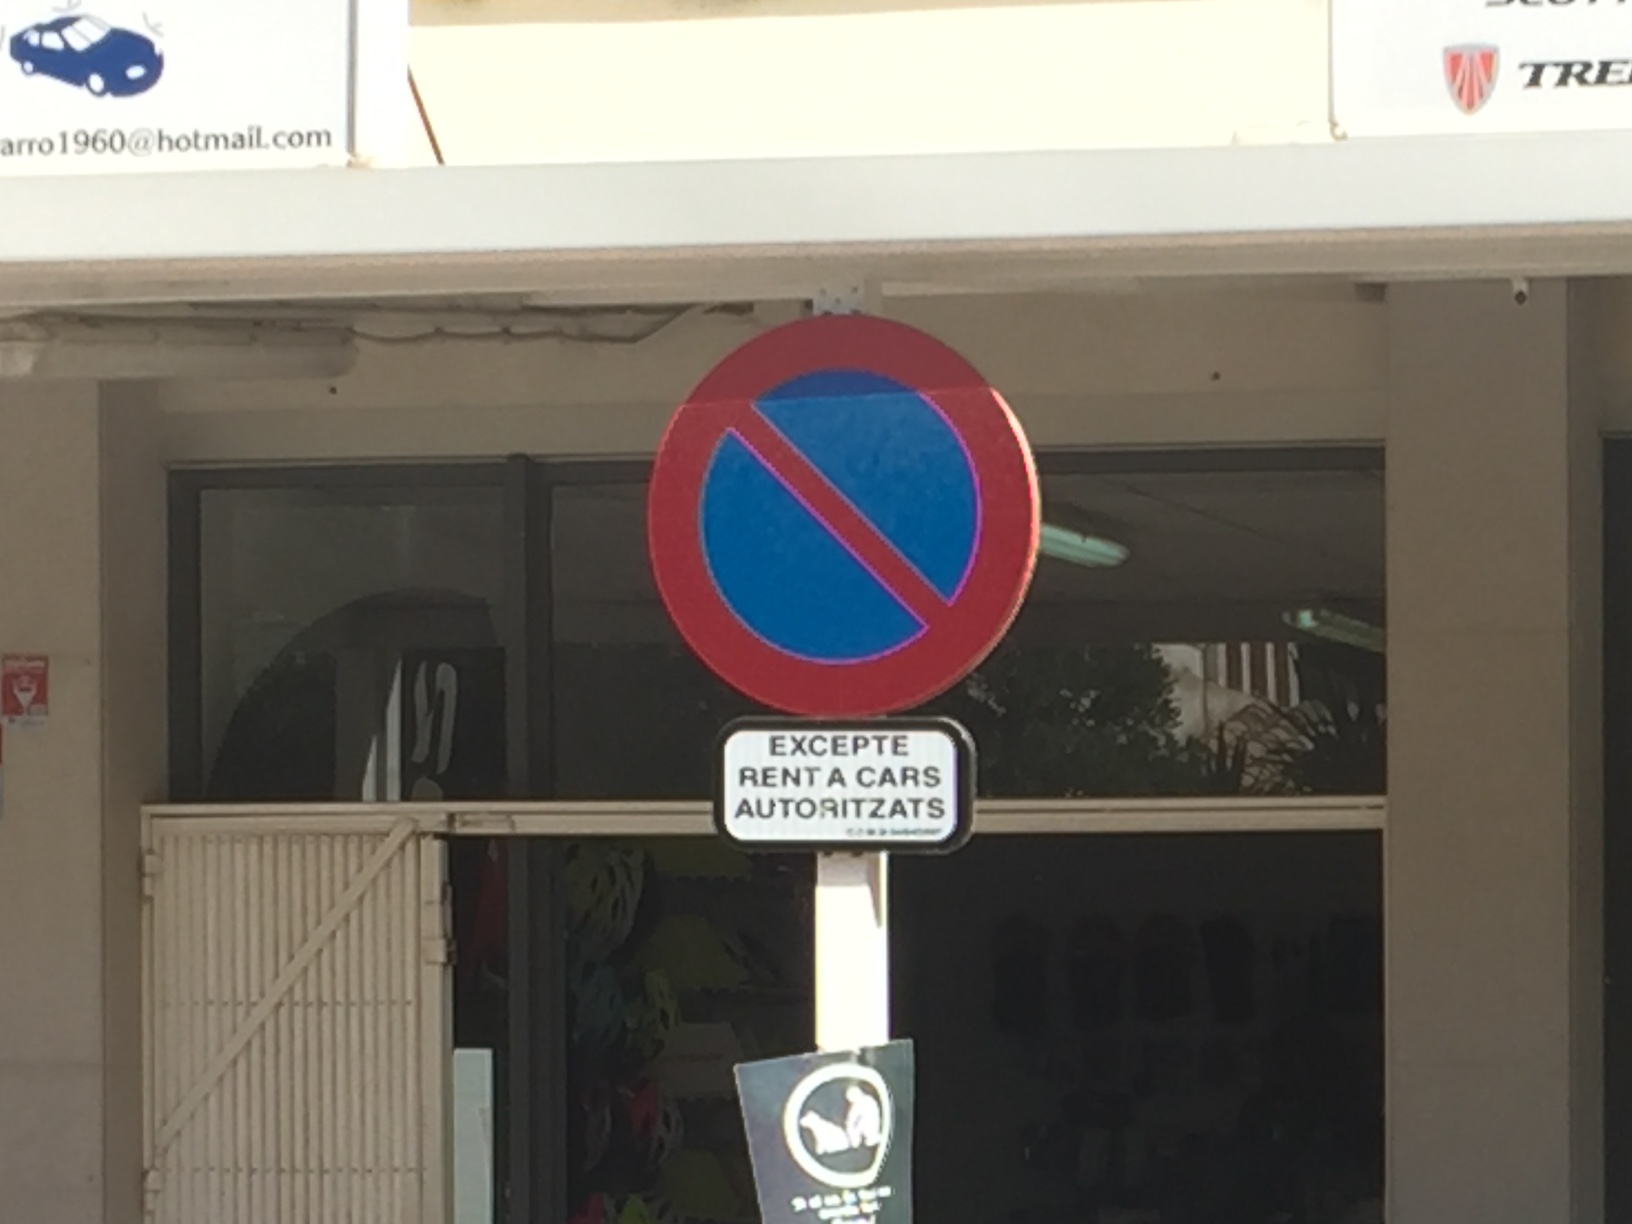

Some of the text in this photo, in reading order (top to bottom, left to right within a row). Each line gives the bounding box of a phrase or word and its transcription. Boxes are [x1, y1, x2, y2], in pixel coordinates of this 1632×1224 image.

[769, 735, 909, 756] EXCEPTE
[739, 767, 941, 788] RENT A CARS
[734, 797, 945, 819] AUTORITZATS
